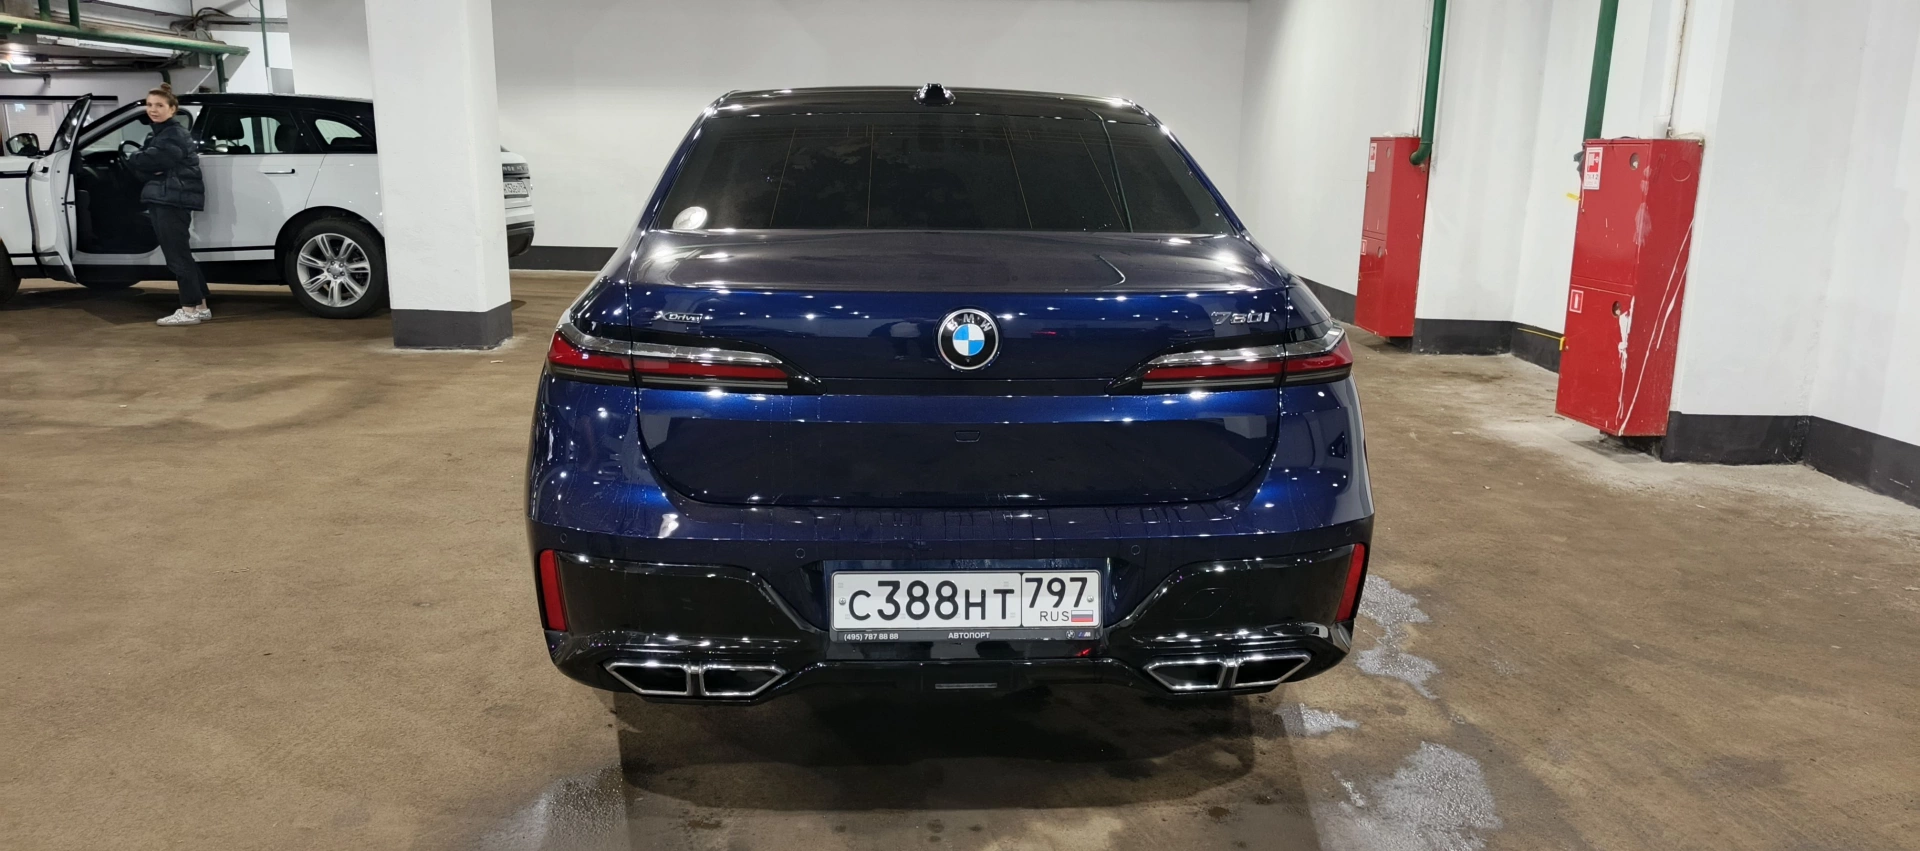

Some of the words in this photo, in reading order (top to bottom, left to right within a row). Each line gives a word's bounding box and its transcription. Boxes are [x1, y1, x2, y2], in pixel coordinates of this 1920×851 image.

[946, 313, 992, 332] BMW
[1024, 577, 1088, 609] 797
[1039, 610, 1070, 622] RUS
[844, 633, 863, 642] (495)
[889, 632, 899, 640] 88
[947, 631, 991, 639] АВТОПОРТ
